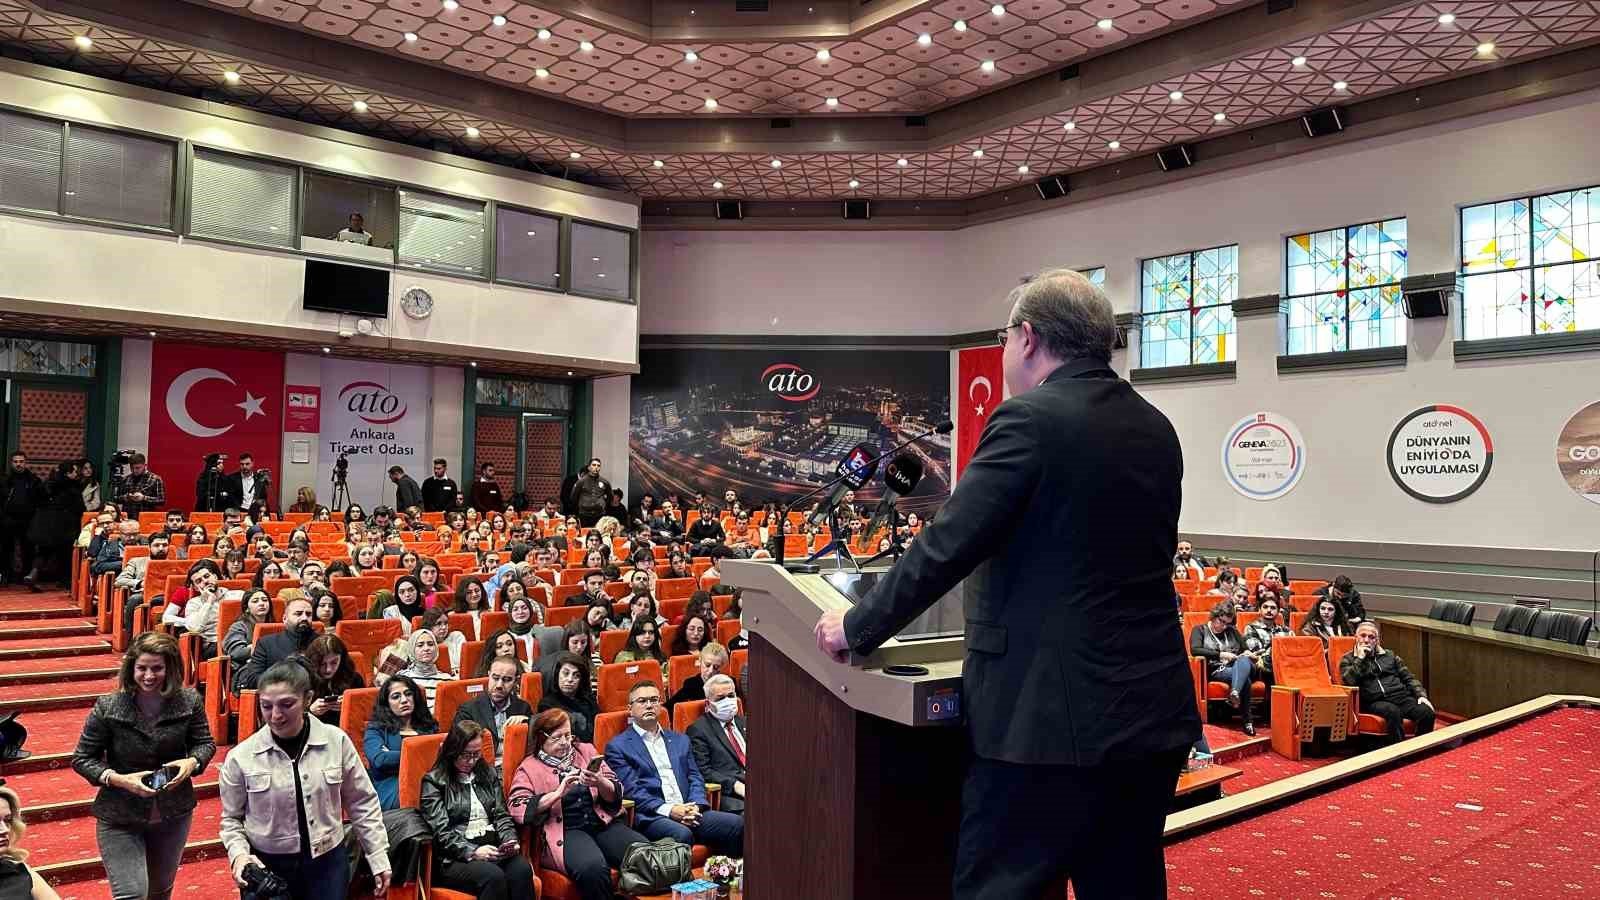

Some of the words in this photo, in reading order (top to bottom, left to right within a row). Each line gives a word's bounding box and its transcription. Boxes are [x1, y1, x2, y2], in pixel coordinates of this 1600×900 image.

[768, 370, 813, 392] ato
[348, 390, 399, 414] ato
[350, 428, 395, 440] Ankara
[1406, 435, 1471, 448] DÜNYANIN
[329, 442, 374, 455] Ticaret
[378, 443, 414, 456] Odası
[1407, 451, 1422, 461] EN
[1423, 449, 1438, 461] İYİ
[1400, 464, 1479, 475] UYGULAMASI
